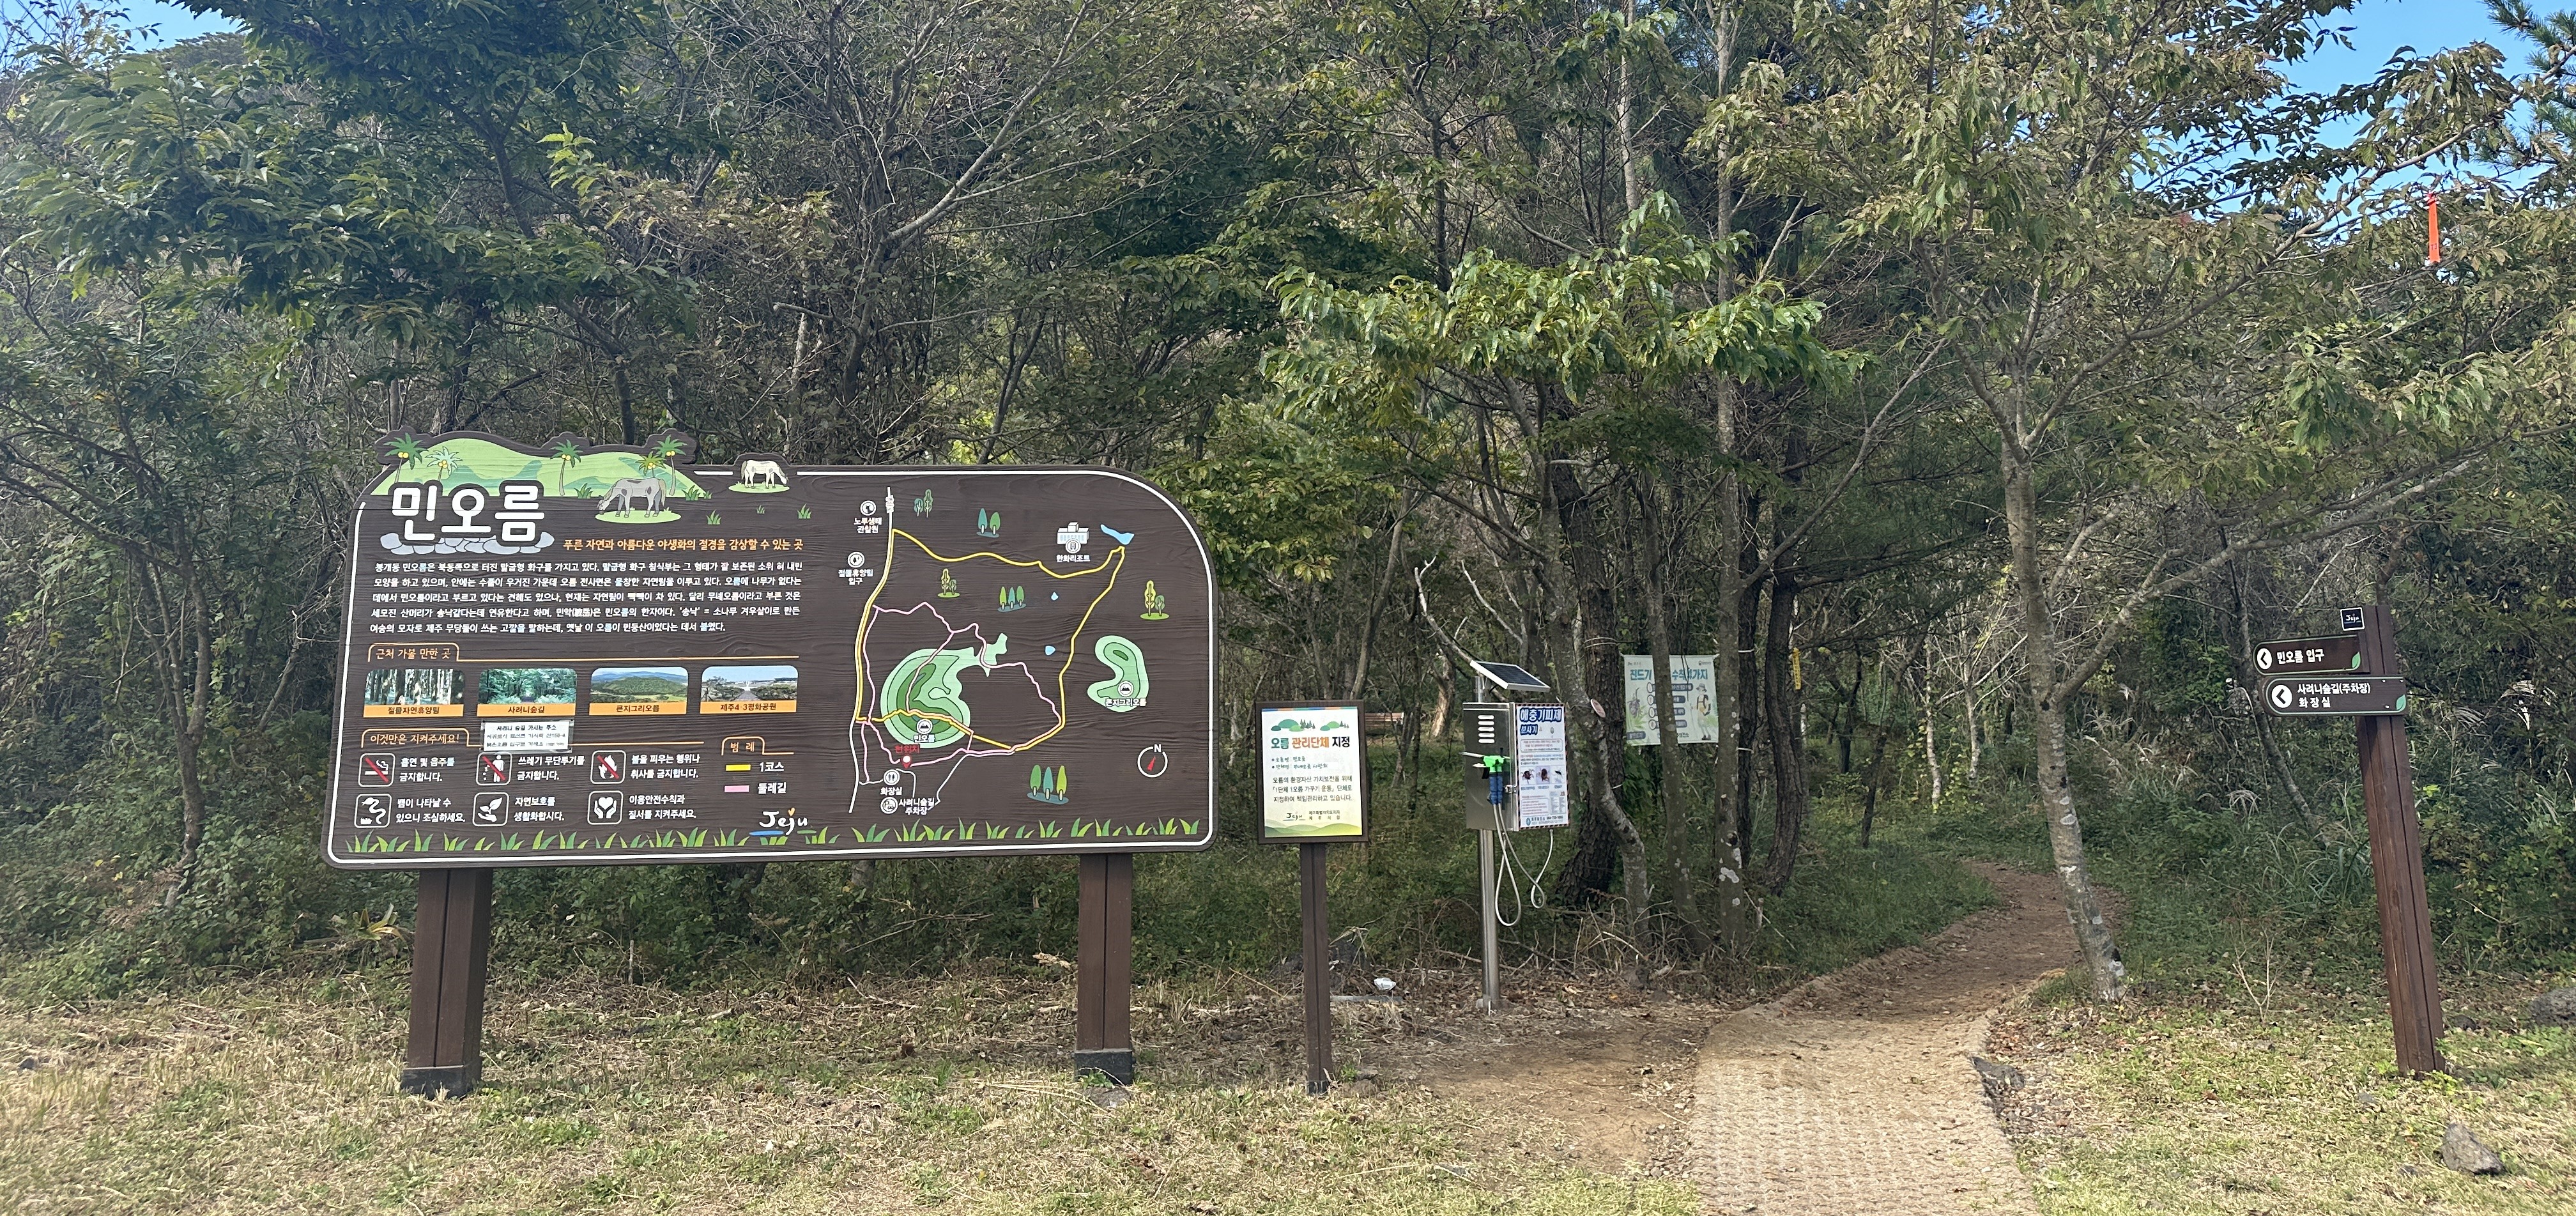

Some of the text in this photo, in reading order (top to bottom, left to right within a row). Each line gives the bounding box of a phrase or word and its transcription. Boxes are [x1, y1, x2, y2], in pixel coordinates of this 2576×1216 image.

[392, 484, 545, 542] 민오름
[854, 517, 882, 525] 노루생태
[563, 539, 802, 550] 푸른 자연과 아름다운 야생화의 절경을 감상할 수 있는 곳
[1056, 554, 1091, 562] 한화리조트
[402, 563, 435, 571] 민오름은
[438, 563, 479, 572] 북동쪽으로
[482, 562, 497, 571] 터진
[527, 562, 552, 571] 화구를
[555, 562, 579, 571] 가지고
[582, 562, 599, 571] 있다.
[629, 562, 646, 571] 화구
[648, 562, 680, 571] 침식부는
[694, 562, 717, 571] 형태가
[721, 562, 728, 571] 잘
[731, 562, 755, 571] 보존된
[758, 562, 773, 571] 소위
[374, 578, 399, 587] 모양을
[402, 578, 418, 587] 하고
[422, 578, 448, 587] 있으며,
[506, 578, 530, 587] 우거진
[533, 578, 557, 587] 가운데
[560, 578, 576, 587] 오름
[642, 577, 673, 586] 자연림을
[677, 577, 700, 586] 이루고
[704, 576, 721, 585] 있다.
[724, 577, 748, 585] 오름에
[751, 577, 775, 585] 나무가
[778, 576, 801, 585] 없다는
[372, 593, 397, 602] 데에서
[401, 593, 448, 602] 민오름이라고
[452, 593, 477, 602] 부르고
[480, 593, 505, 602] 있다는
[535, 593, 561, 602] 있으나,
[565, 592, 590, 601] 현재는
[593, 593, 624, 601] 자연림이
[656, 592, 664, 601] 차
[668, 592, 685, 601] 있다.
[689, 592, 704, 601] 달리
[785, 591, 801, 600] 것은
[371, 608, 396, 617] 세모진
[400, 608, 433, 617] 산머리가
[489, 608, 529, 617] 연유한다고
[533, 608, 551, 617] 하며,
[605, 608, 636, 617] 민오름의
[713, 607, 737, 615] 소나무
[784, 606, 800, 615] 만든
[370, 624, 394, 633] 여승의
[397, 624, 422, 633] 모자로
[425, 624, 442, 633] 제주
[445, 624, 478, 633] 무당들이
[480, 624, 497, 633] 쓰는
[528, 624, 563, 633] 말하는데,
[566, 623, 583, 632] 옛날
[585, 623, 593, 632] 이
[595, 623, 620, 632] 오름이
[681, 622, 696, 631] 데서
[376, 648, 451, 659] 근처 가볼 만한 곳
[2277, 649, 2324, 664] 민오름 입구
[1630, 668, 1652, 681] 진드기
[2297, 682, 2372, 695] 사려니숲길(주차장)
[507, 705, 545, 714] 사려니숲길
[1520, 708, 1562, 721] 해충기피제
[371, 732, 459, 744] 이것만은 지켜주세요!
[914, 734, 935, 743] 민오름
[1271, 736, 1349, 749] 오름 관리단체 지정
[894, 745, 920, 753] 현위치
[1154, 744, 1162, 753] N
[401, 757, 454, 767] 흡연 및 음주를
[518, 755, 585, 766] 쓰레기 무단투기를
[631, 754, 700, 764] 불을 피우는 행위나
[760, 761, 785, 773] 1코스
[399, 772, 442, 781] 금지합니다.
[517, 771, 559, 780] 금지합니다.
[631, 769, 698, 779] 취사를 금지합니다.
[757, 781, 787, 795] 둘레길
[880, 787, 903, 796] 화장실
[397, 797, 451, 808] 뱀이 나타날 수
[515, 796, 555, 806] 자연보호를
[629, 794, 685, 804] 이용안전수칙과
[898, 797, 935, 806] 사려니숲길
[629, 809, 696, 819] 질서를 지켜주세요.
[905, 806, 928, 815] 주차장
[396, 812, 465, 822] 있으니 조심하세요.
[514, 811, 564, 821] 생활화합시다.
[759, 810, 809, 836] Jeju
